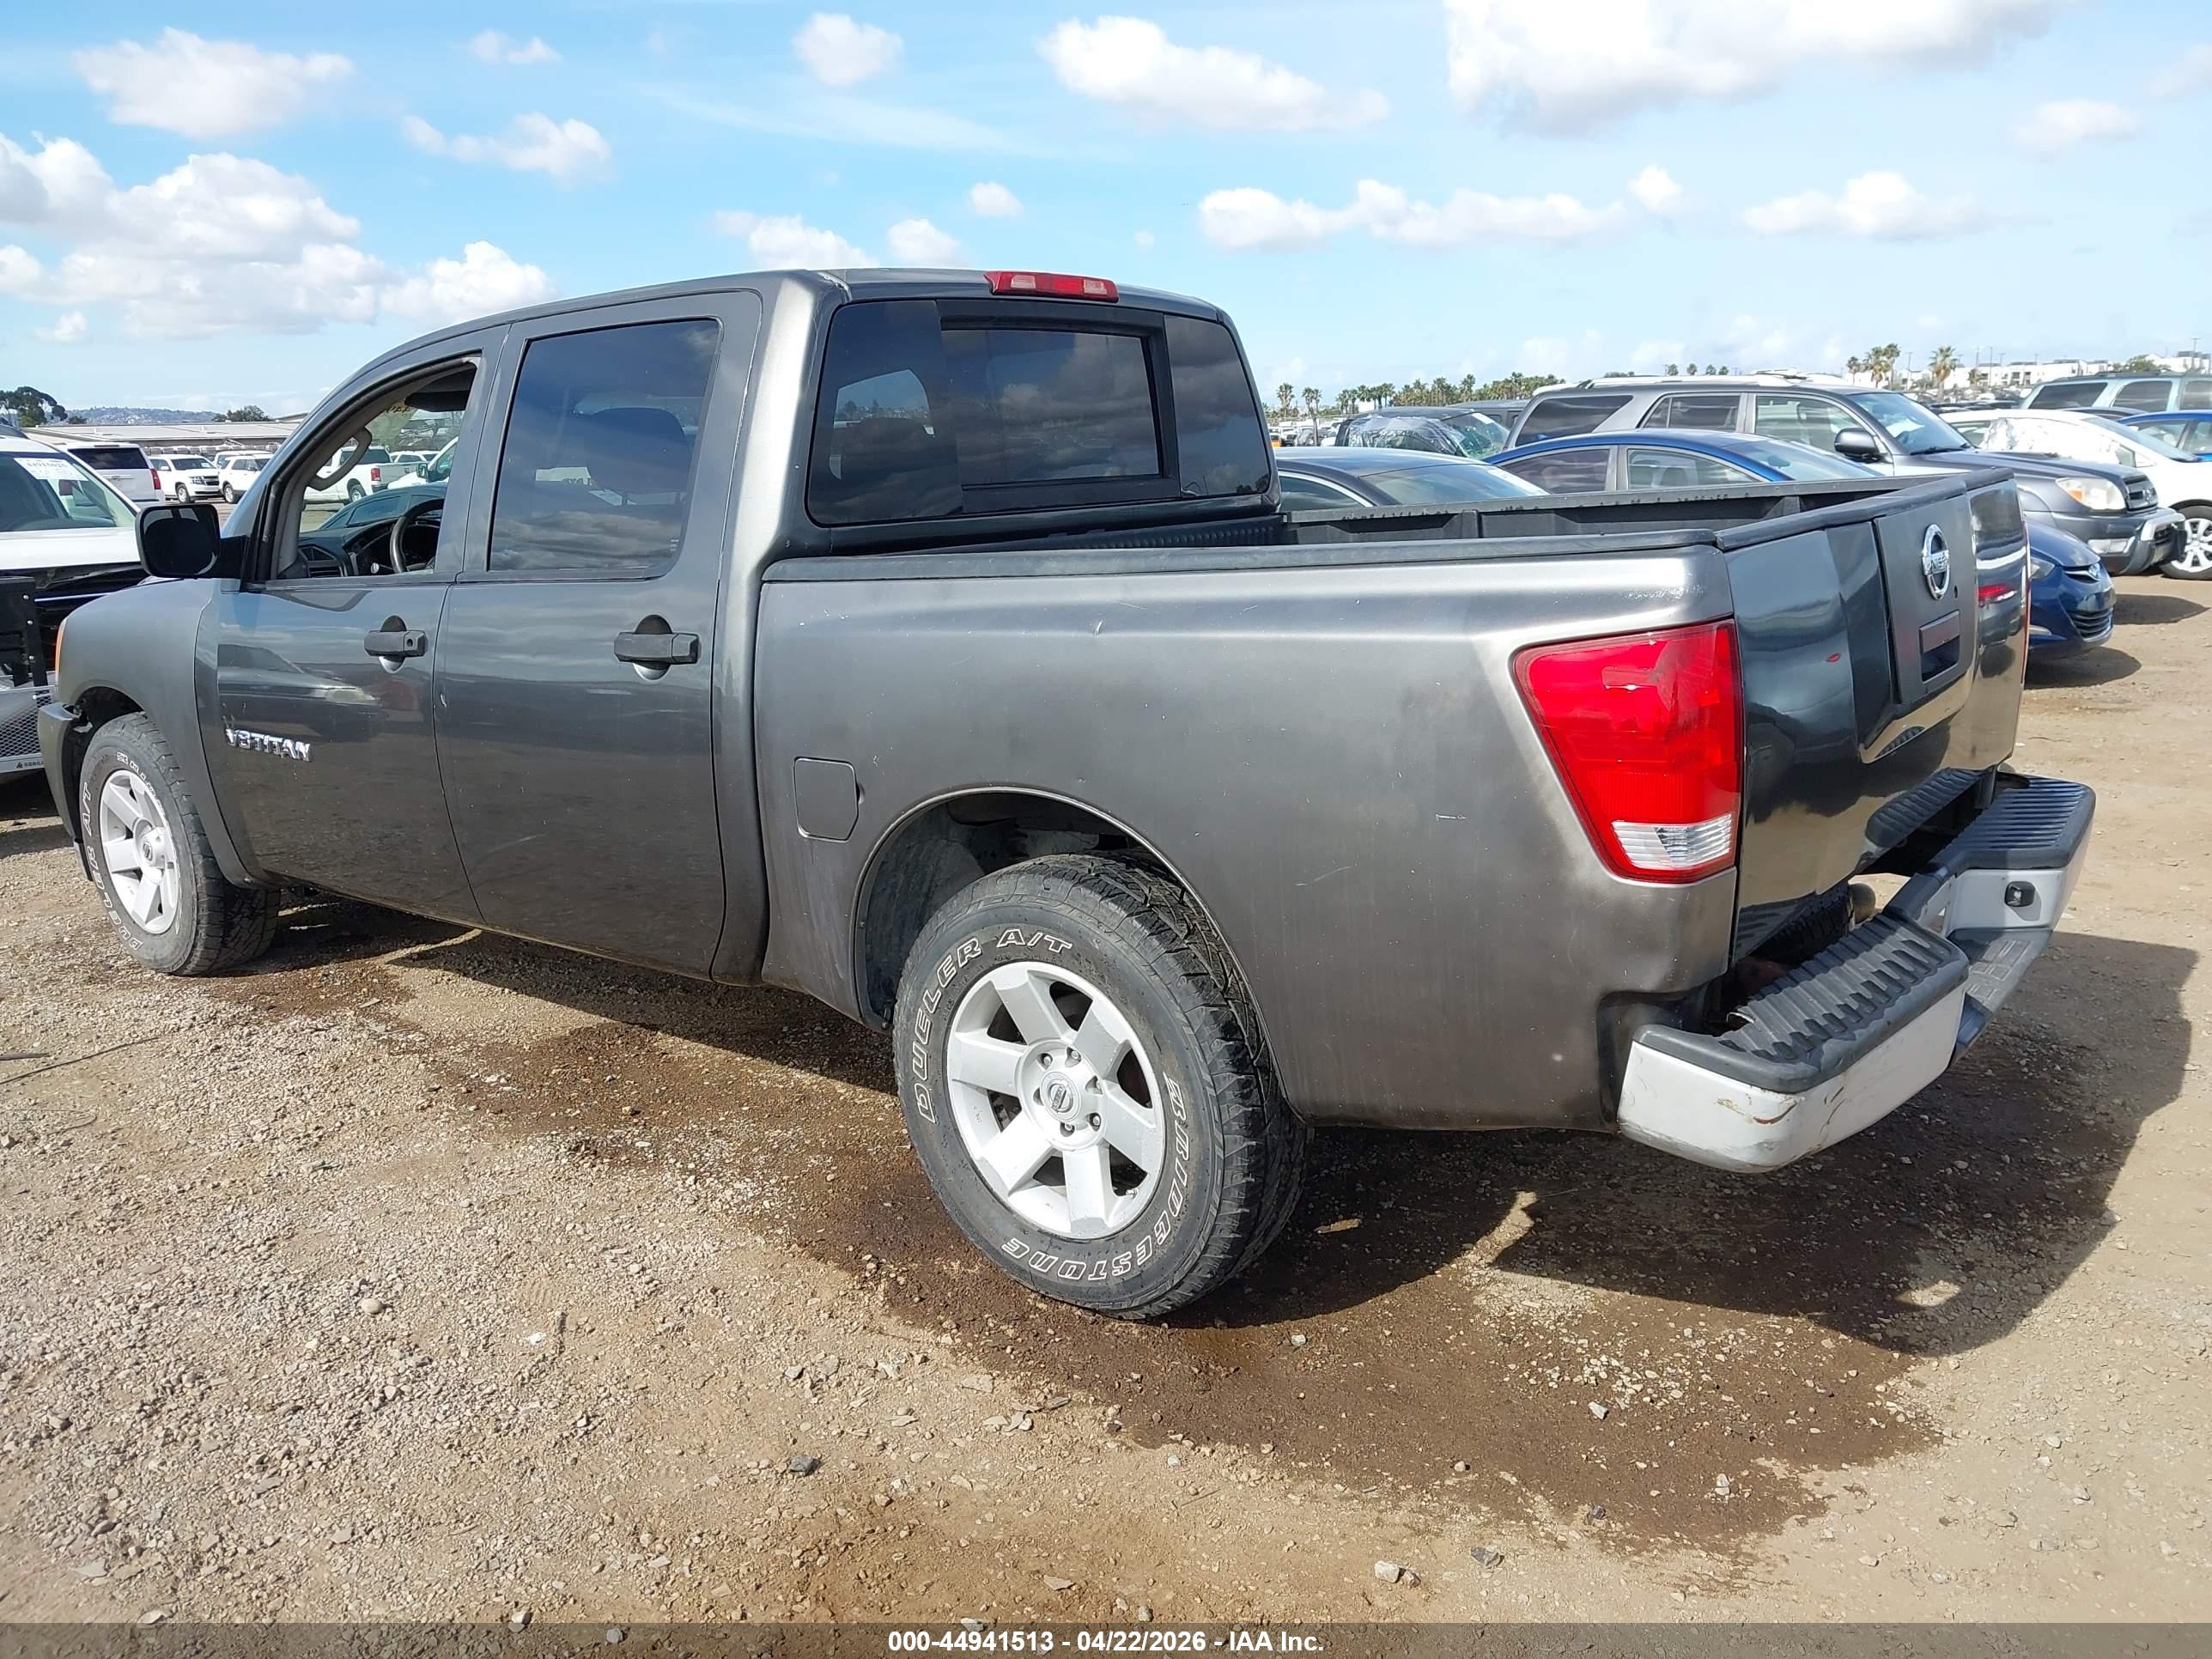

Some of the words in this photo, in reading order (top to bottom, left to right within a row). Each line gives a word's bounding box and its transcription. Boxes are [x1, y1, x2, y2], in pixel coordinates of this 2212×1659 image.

[912, 937, 982, 1124] DUELER
[996, 928, 1073, 953] A/T
[1001, 1072, 1189, 1281] BRIDGESTONE
